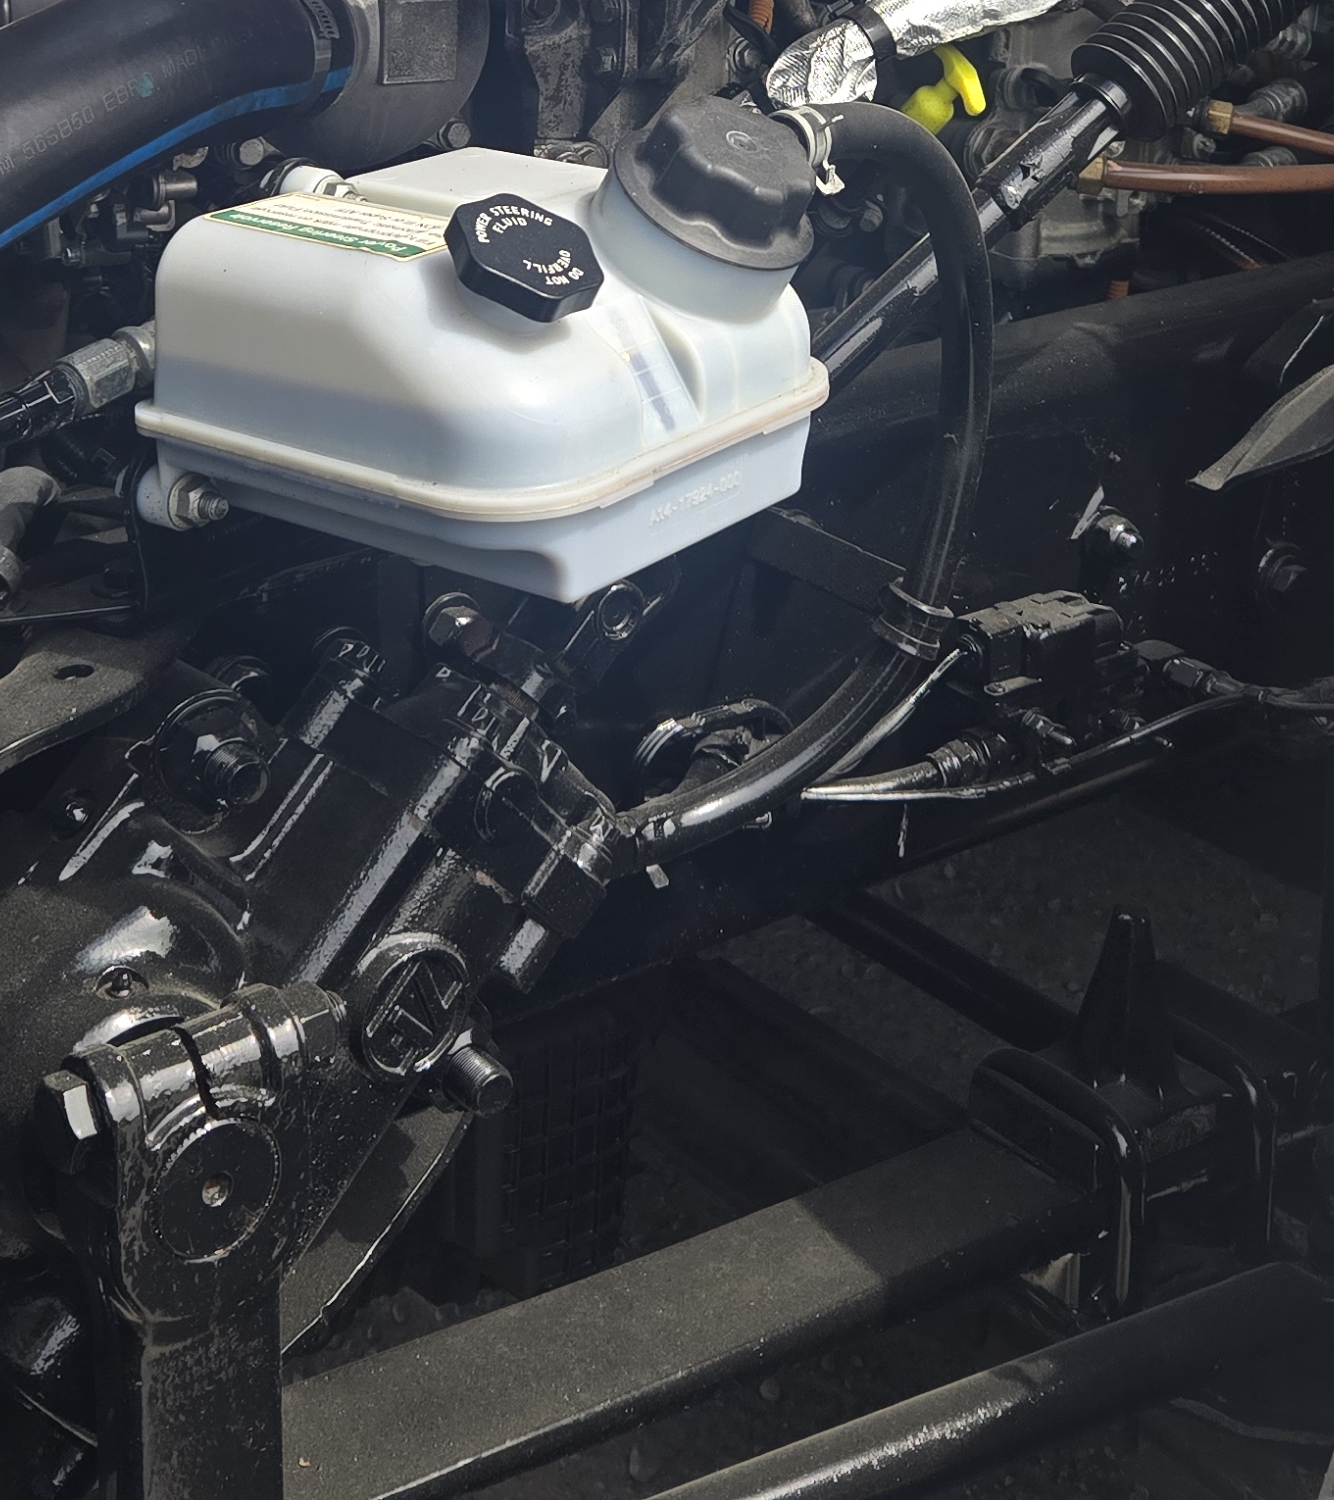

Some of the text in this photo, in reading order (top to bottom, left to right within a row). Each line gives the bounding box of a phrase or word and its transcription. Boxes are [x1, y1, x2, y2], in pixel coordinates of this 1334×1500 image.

[229, 212, 299, 232] Reservoir
[475, 205, 553, 243] POWER STEERING
[492, 217, 528, 234] FLUID
[298, 225, 359, 244] Steering
[523, 249, 571, 274] OVERFILL
[545, 267, 585, 285] DO NOT
